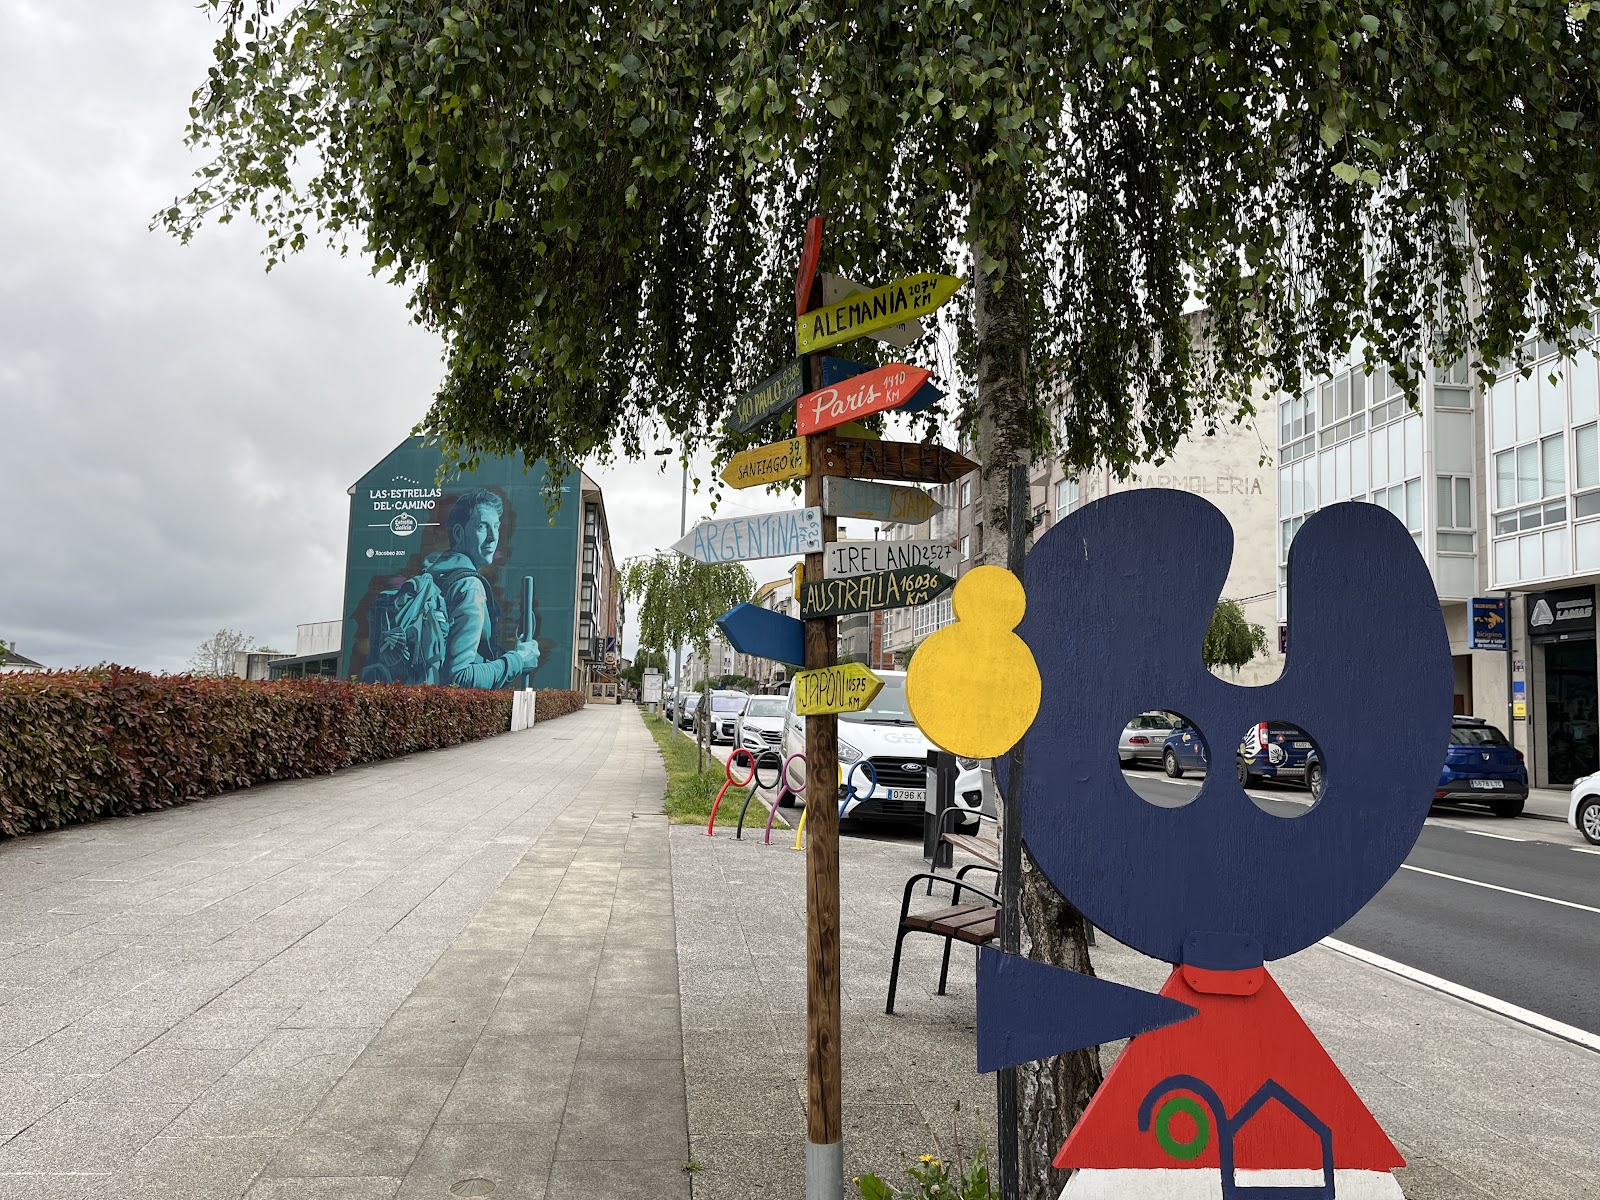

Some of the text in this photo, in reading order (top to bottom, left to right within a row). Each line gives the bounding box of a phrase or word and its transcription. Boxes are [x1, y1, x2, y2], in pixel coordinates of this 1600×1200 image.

[908, 279, 937, 296] 2074
[914, 293, 931, 309] KM
[883, 371, 906, 389] 1410
[754, 380, 781, 416] PAULO
[885, 389, 900, 403] KM
[810, 384, 881, 425] Paris
[789, 440, 800, 455] 39
[738, 455, 788, 480] SANTIAGO
[790, 456, 802, 469] KM
[834, 440, 951, 482] TALLER
[837, 543, 921, 574] IRELAND
[923, 545, 952, 559] 2527
[900, 573, 938, 592] 16036
[905, 591, 929, 606] KM
[1555, 606, 1593, 620] LAMAS
[848, 696, 860, 709] KM
[893, 790, 915, 799] 0796
